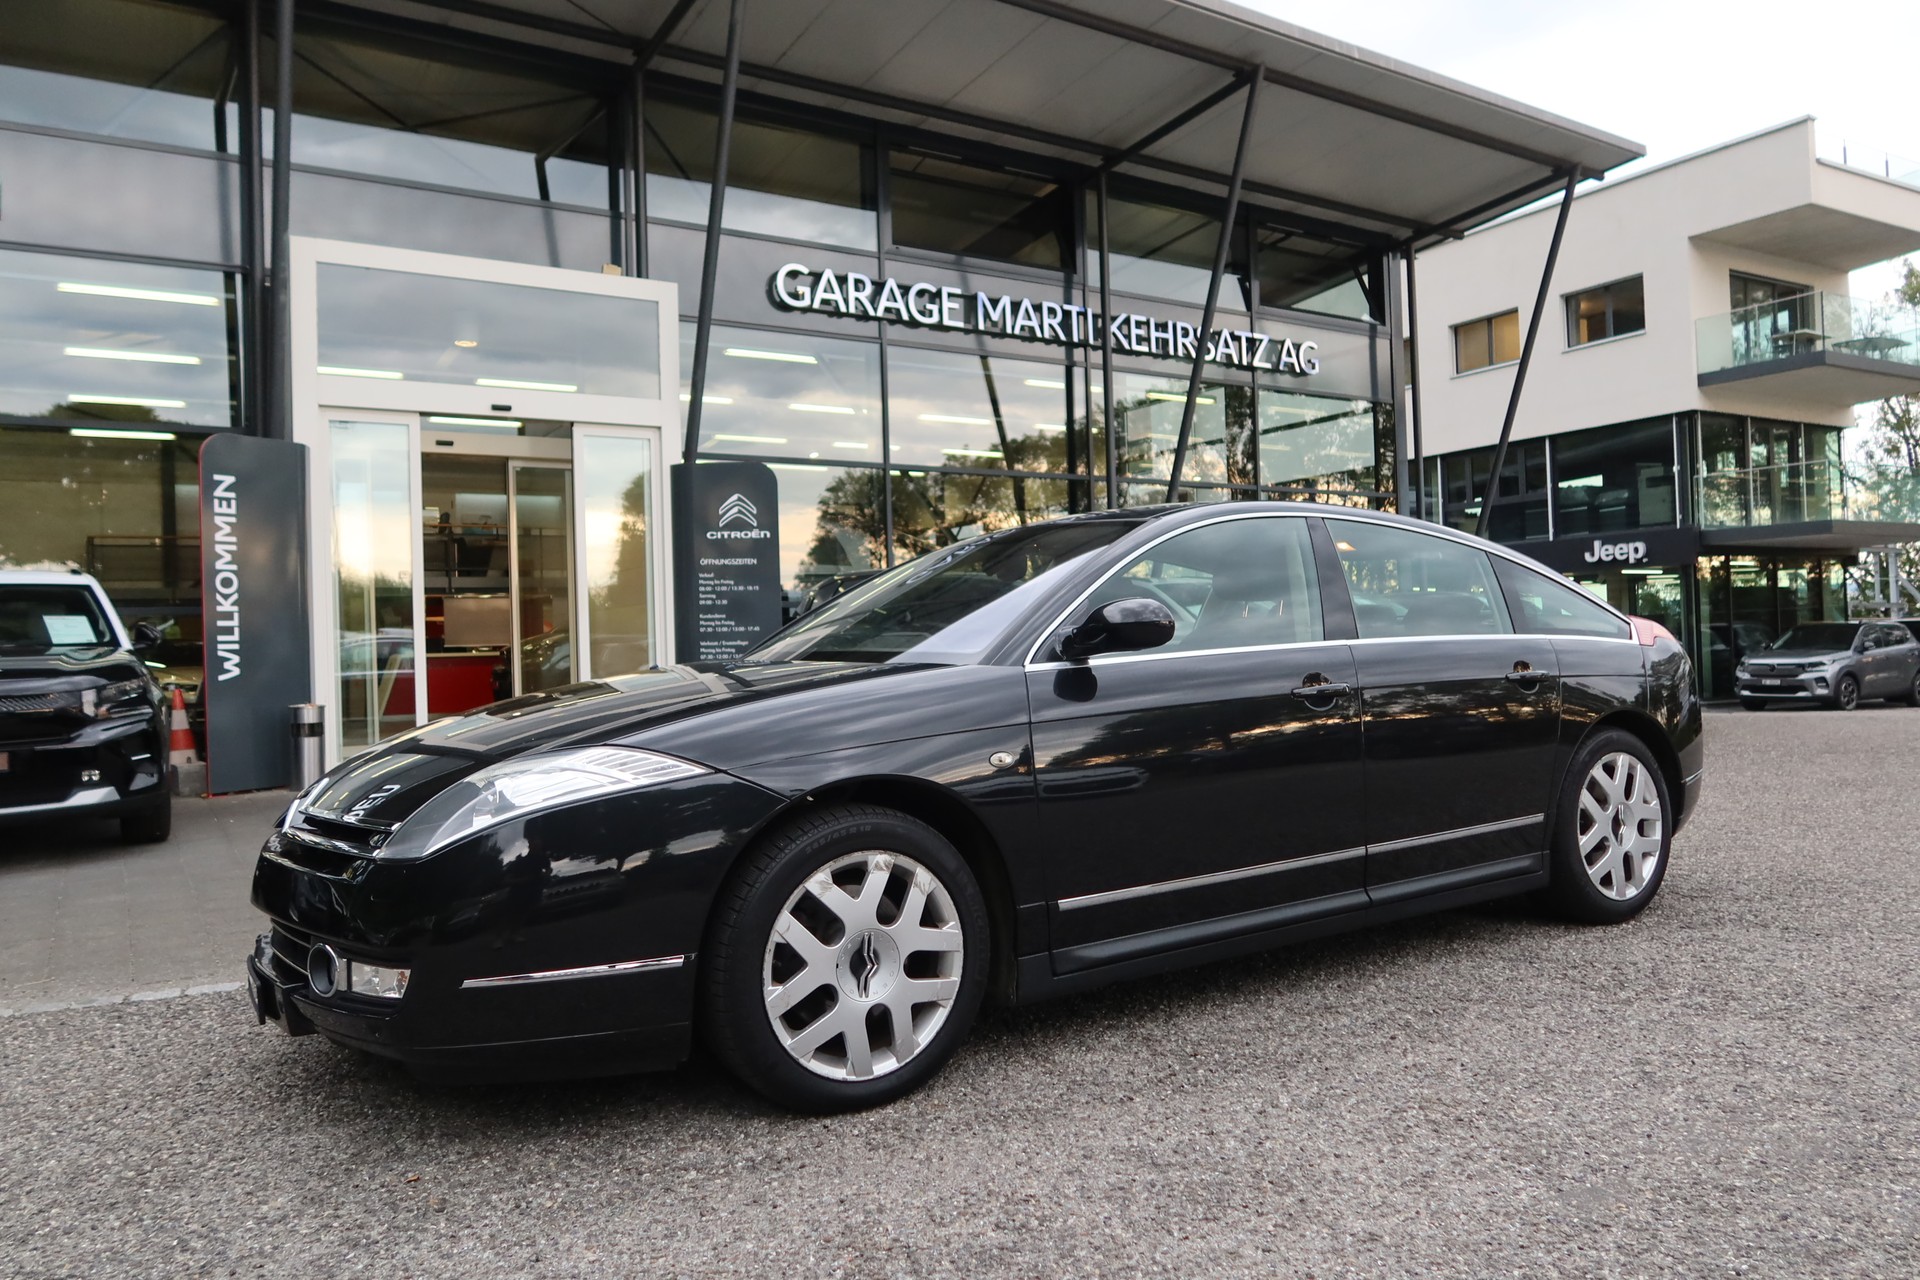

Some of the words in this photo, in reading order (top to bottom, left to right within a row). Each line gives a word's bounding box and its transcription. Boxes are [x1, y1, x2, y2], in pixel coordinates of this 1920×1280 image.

[775, 262, 967, 330] GARAGE
[976, 290, 1096, 347] MARTI
[1110, 312, 1272, 370] KEHRSATZ
[1278, 338, 1321, 377] AG
[212, 473, 242, 682] WILLKOMMEN
[700, 558, 757, 566] ÖFFNUNGSZEITEN
[1584, 539, 1648, 564] Jeep
